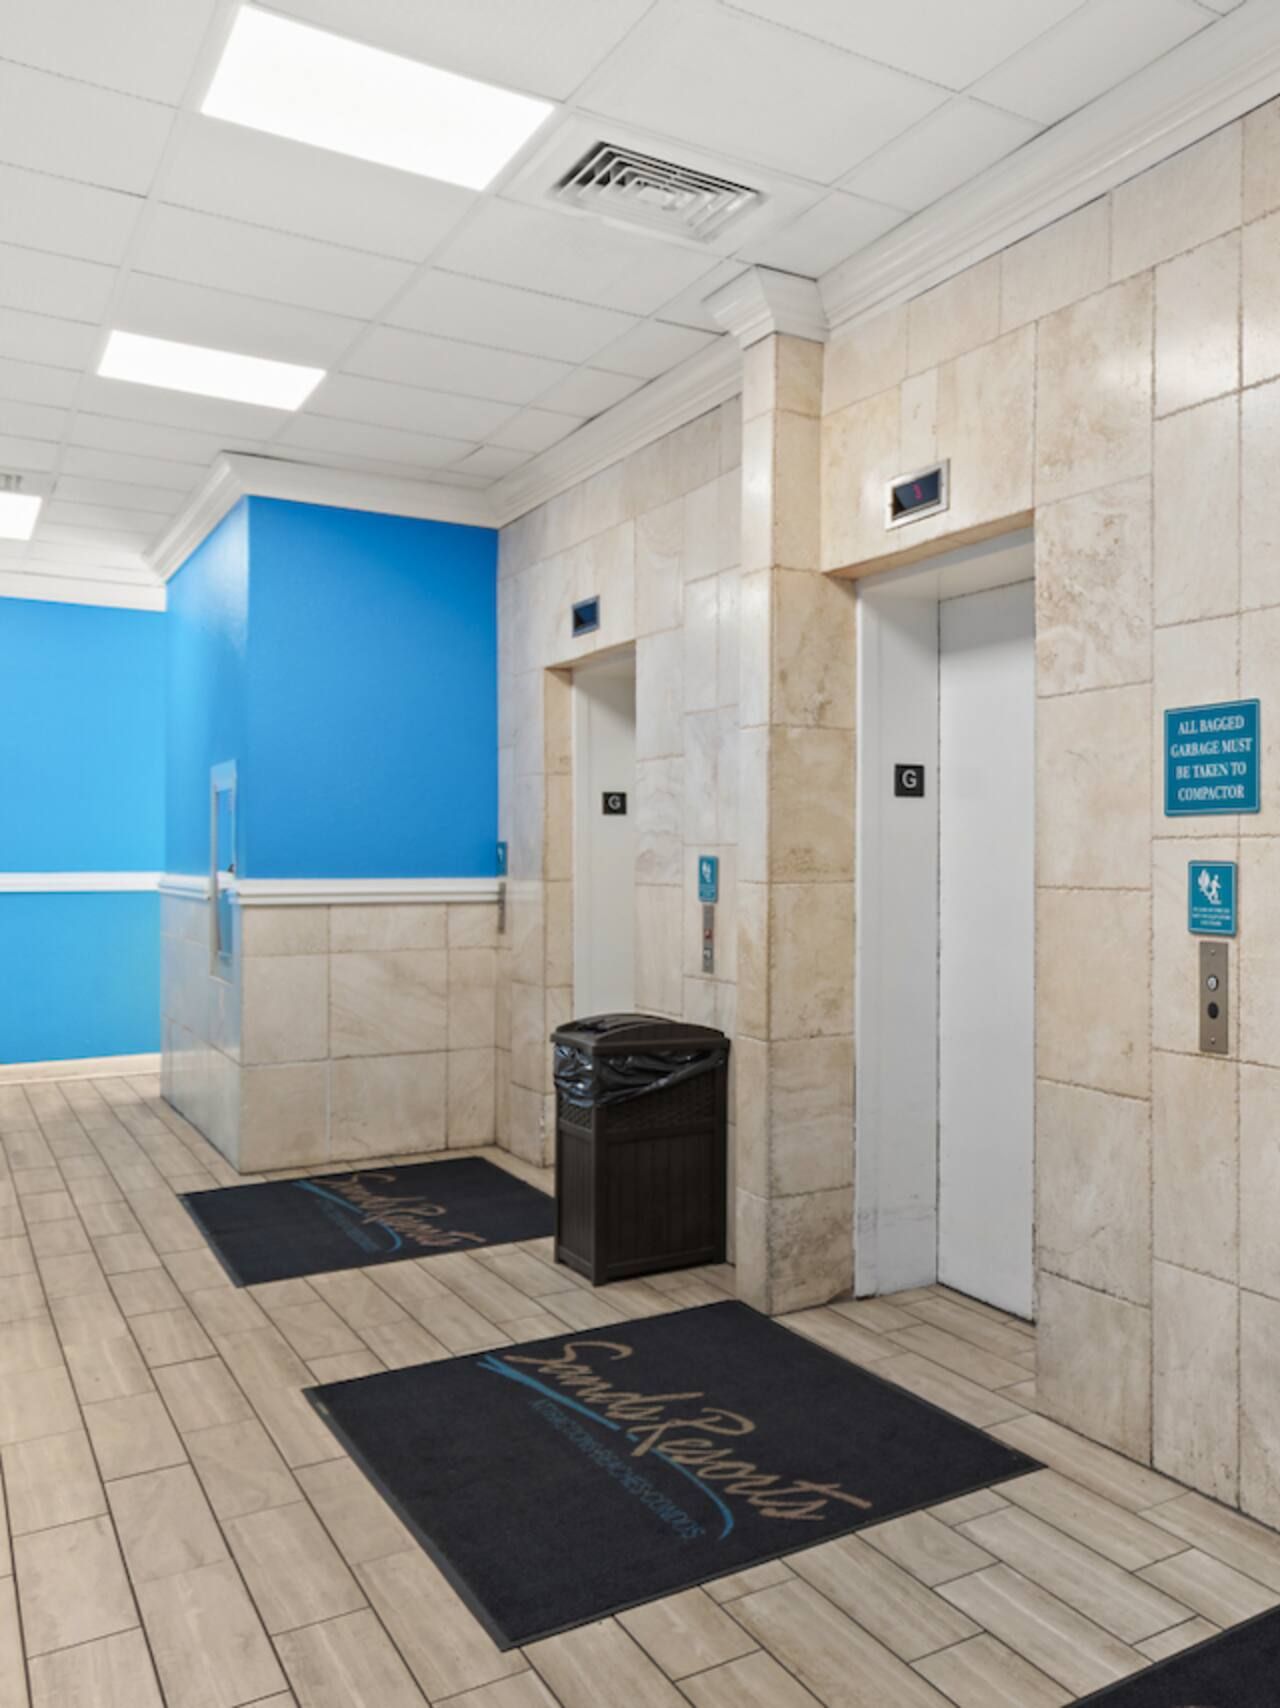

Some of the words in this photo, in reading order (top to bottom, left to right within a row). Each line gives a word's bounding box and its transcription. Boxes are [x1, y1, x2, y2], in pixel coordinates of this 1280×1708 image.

[1178, 720, 1198, 735] ALL
[1200, 715, 1245, 733] BAGGED
[1170, 739, 1220, 758] GARBAGE
[1222, 737, 1253, 754] MUST
[902, 769, 917, 788] G
[1175, 765, 1190, 780] BE
[1192, 762, 1229, 778] TAKEN
[1230, 761, 1247, 776] TO
[1177, 784, 1245, 801] COMPACTOR
[607, 795, 621, 810] G
[504, 1340, 704, 1421] Sands
[625, 1406, 873, 1521] Resorts
